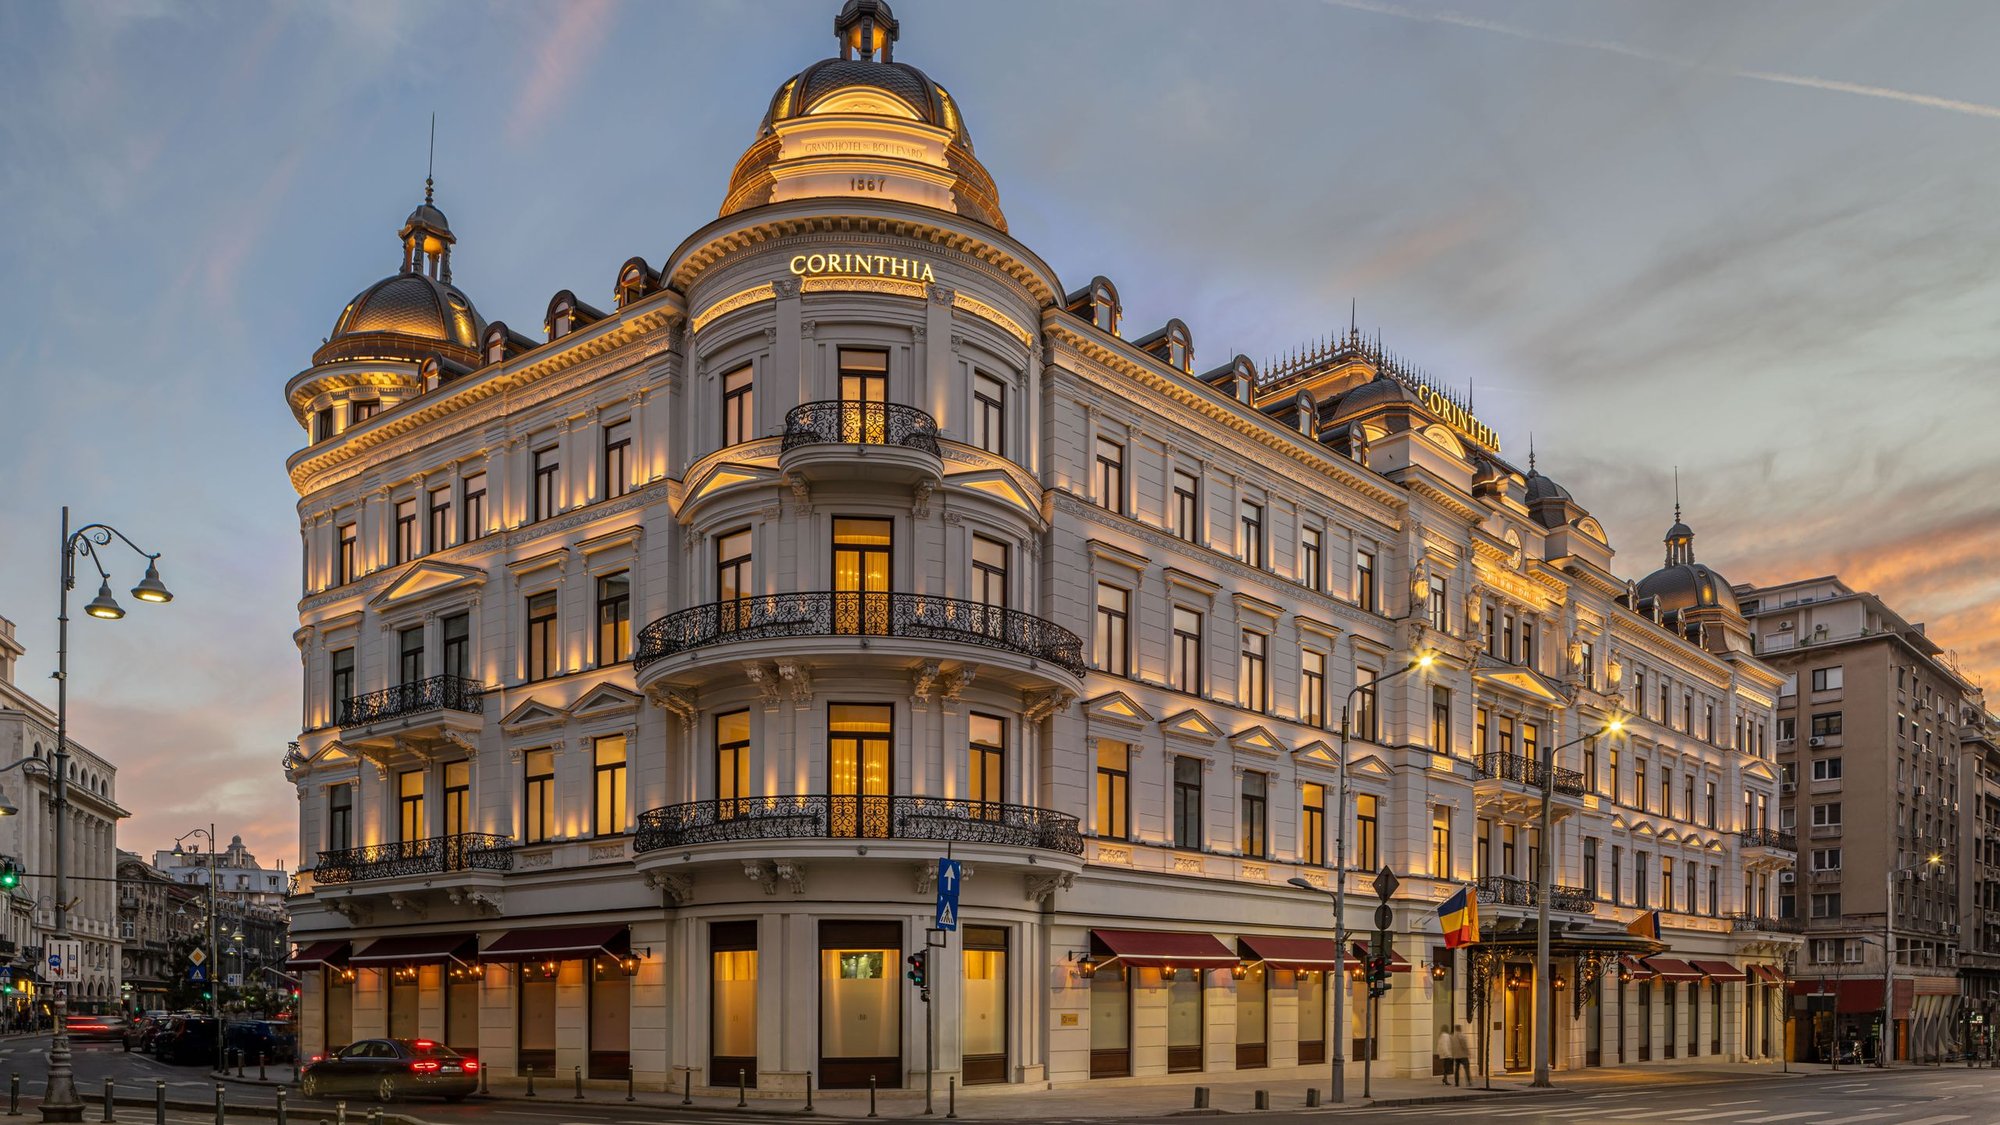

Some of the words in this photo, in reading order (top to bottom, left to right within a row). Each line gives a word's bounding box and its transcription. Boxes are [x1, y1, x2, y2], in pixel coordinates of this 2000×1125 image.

[805, 141, 834, 153] GRAND
[836, 141, 861, 151] HOTEL
[873, 142, 923, 158] BOULEVARD
[850, 177, 886, 192] 1867
[789, 254, 936, 283] CORINTHIA
[1419, 384, 1502, 452] CORINTHIA
